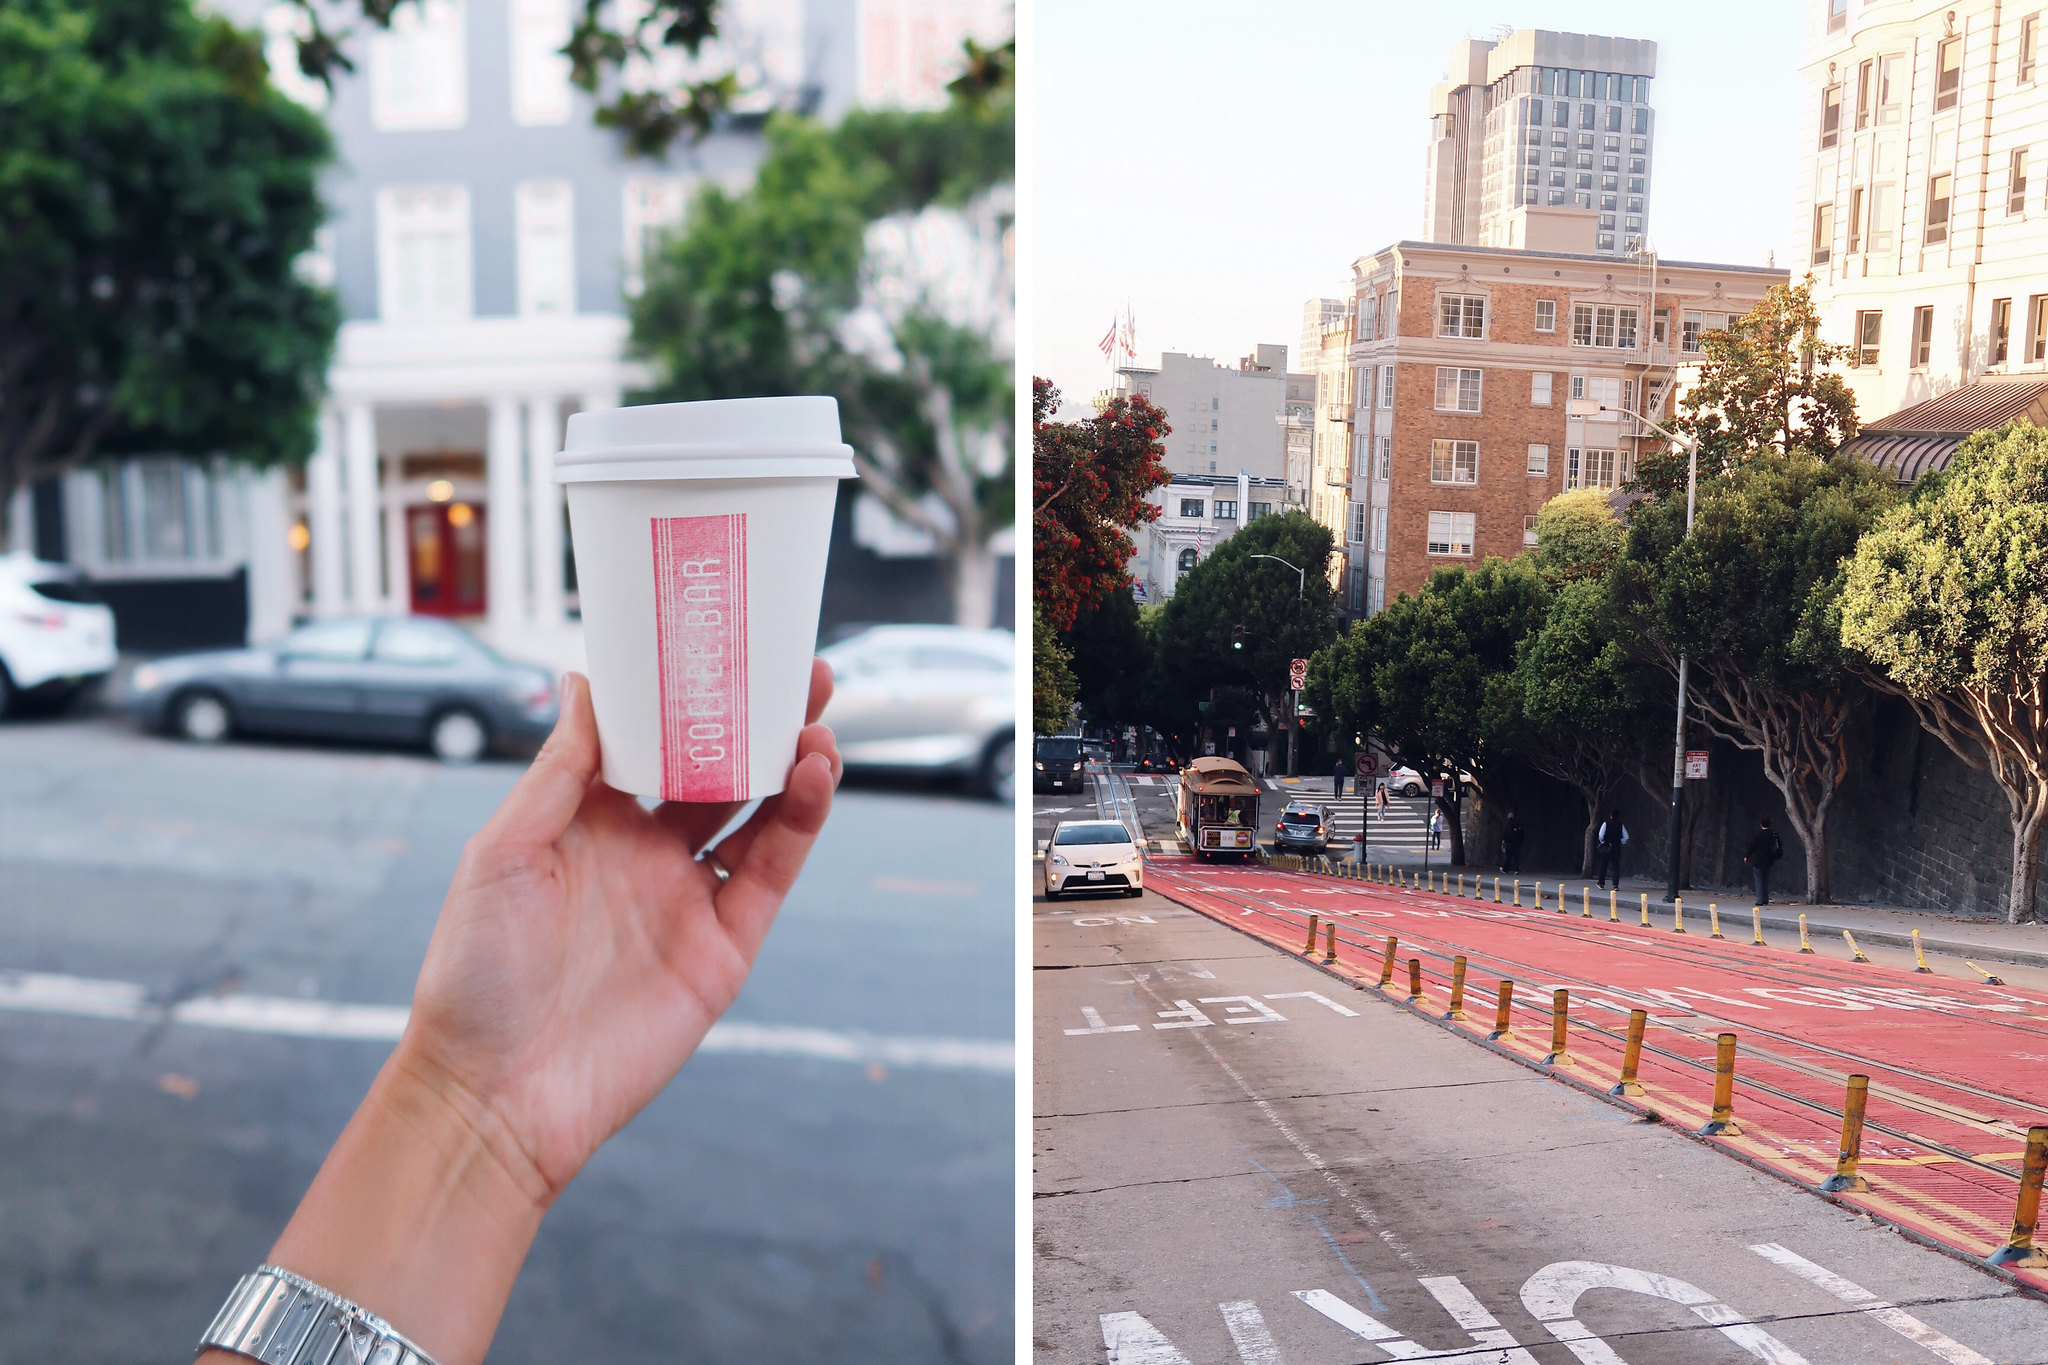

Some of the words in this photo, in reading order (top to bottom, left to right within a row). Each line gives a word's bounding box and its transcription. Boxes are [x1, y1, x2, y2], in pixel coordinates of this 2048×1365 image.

[682, 557, 722, 628] BAR
[686, 644, 726, 762] COFFEE
[1072, 914, 1158, 927] NO
[1063, 990, 1360, 1036] LEFT
